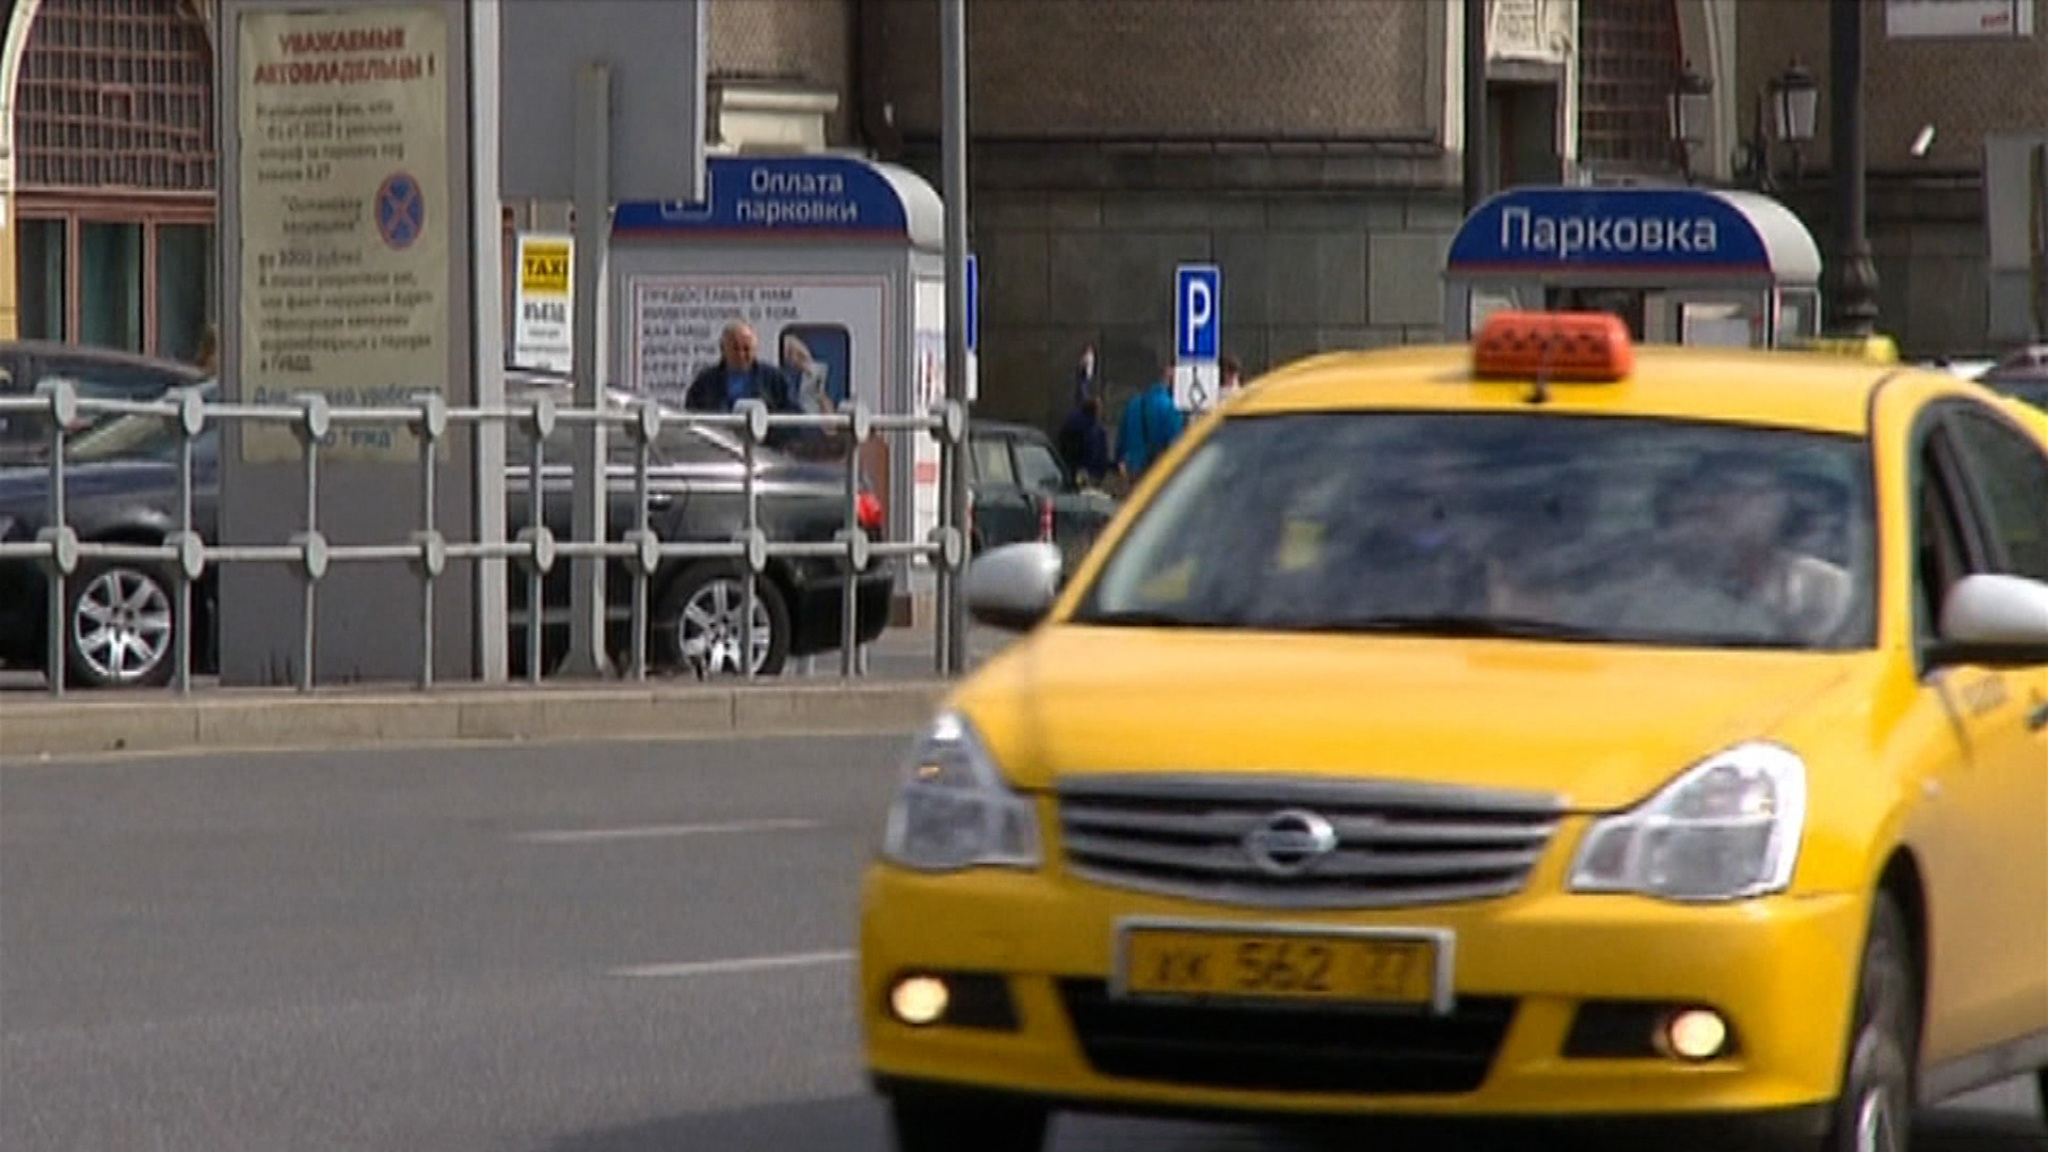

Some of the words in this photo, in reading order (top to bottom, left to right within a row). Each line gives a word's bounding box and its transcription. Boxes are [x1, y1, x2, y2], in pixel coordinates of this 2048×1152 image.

[278, 28, 406, 54] УВАЖАЕМЫЕ
[254, 56, 422, 85] АВТОВЛАДЕЛЬЦЫ
[751, 169, 844, 194] Оплата
[736, 199, 858, 226] парковки
[1501, 206, 1718, 261] Парковка
[525, 259, 569, 276] TAXI
[1188, 277, 1212, 352] P
[1237, 940, 1333, 992] 562
